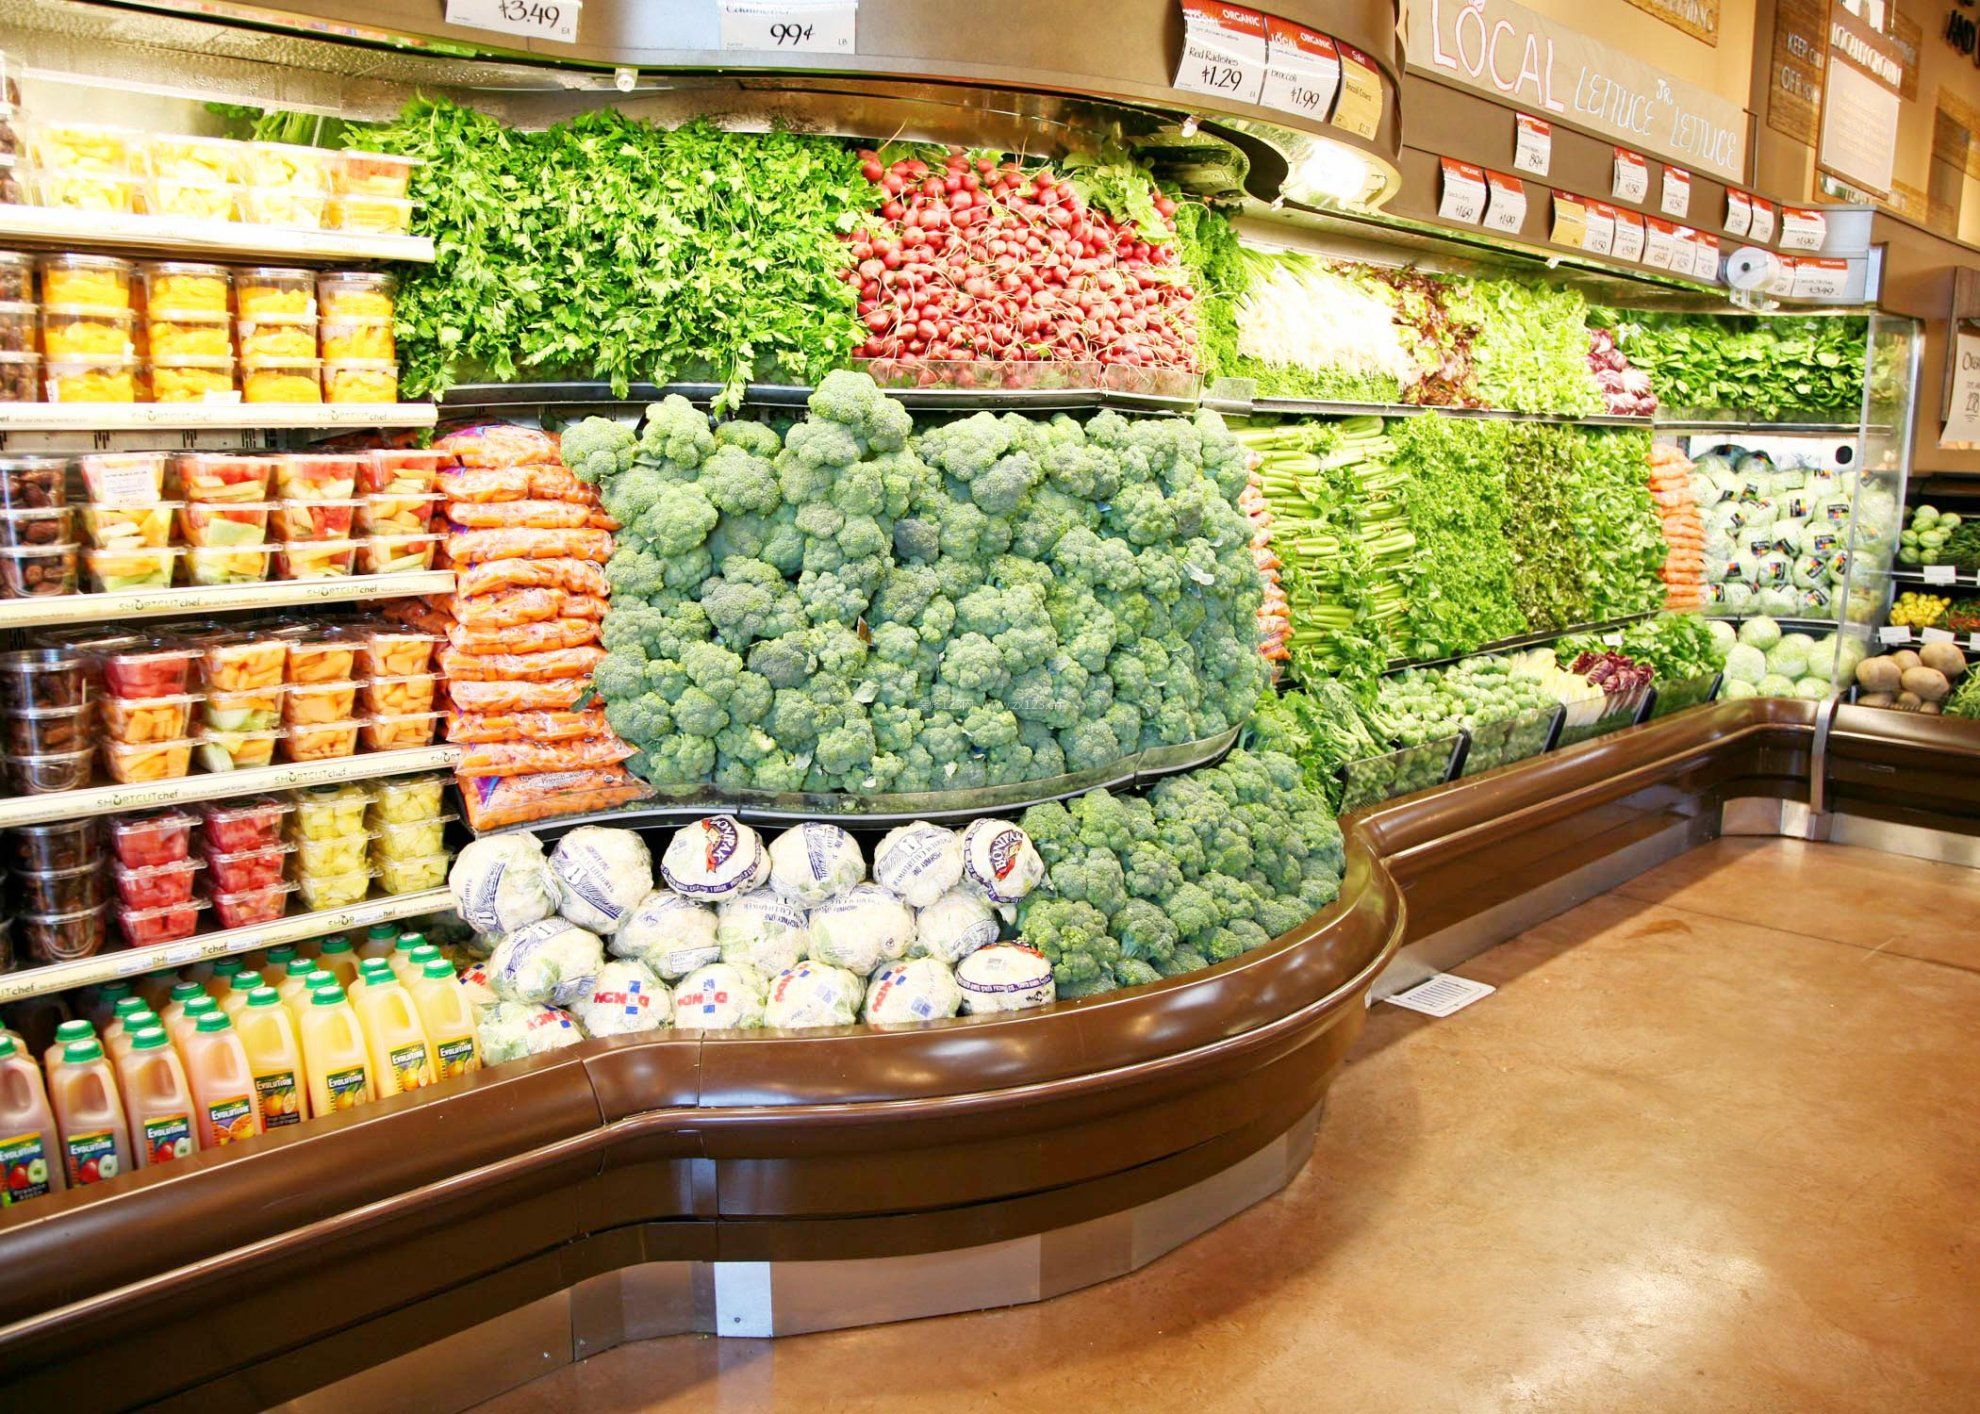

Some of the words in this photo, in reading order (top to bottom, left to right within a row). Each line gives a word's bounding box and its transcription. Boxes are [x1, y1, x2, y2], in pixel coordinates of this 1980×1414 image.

[1222, 9, 1260, 26] ORGANIC
[770, 23, 815, 45] 99¢
[1300, 32, 1333, 50] ORGANIC
[1430, 0, 1565, 113] LOCAL
[1201, 65, 1243, 92] $1.29
[1290, 87, 1320, 110] $1.99
[1574, 66, 1655, 137] LETTUCE
[1669, 105, 1738, 171] LETTUCE
